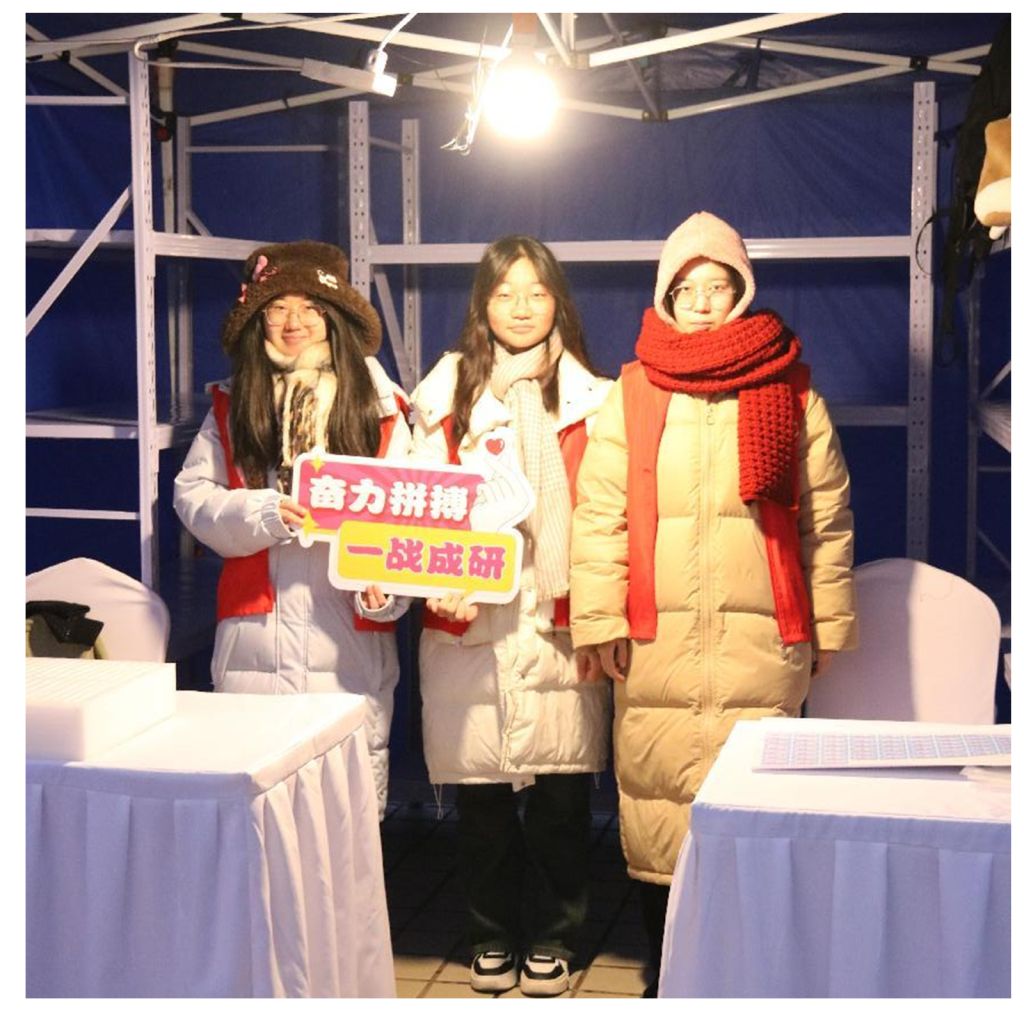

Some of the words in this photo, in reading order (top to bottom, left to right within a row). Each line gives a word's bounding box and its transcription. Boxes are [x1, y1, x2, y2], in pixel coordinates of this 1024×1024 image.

[309, 474, 468, 522] 奋力拼搏
[346, 537, 506, 580] 一战成研
